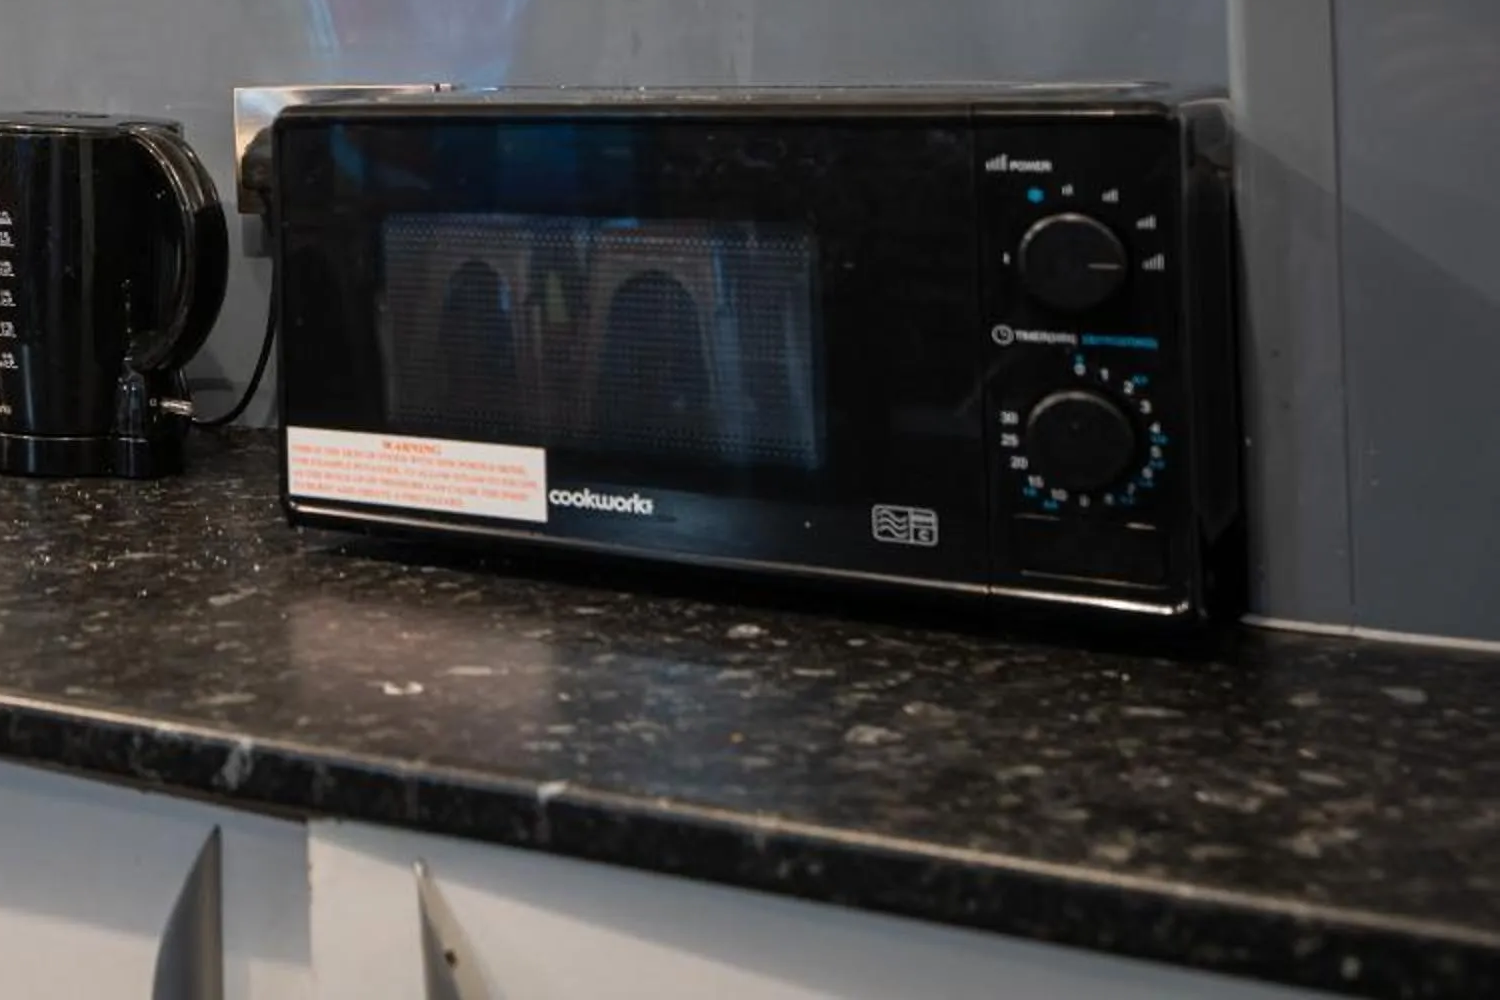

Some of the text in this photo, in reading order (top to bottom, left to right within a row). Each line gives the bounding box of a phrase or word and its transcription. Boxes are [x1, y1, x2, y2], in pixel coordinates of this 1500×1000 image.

[1009, 160, 1053, 172] POWER
[1140, 399, 1152, 415] 3
[382, 440, 442, 457] WARNING
[549, 487, 653, 516] cookworks
